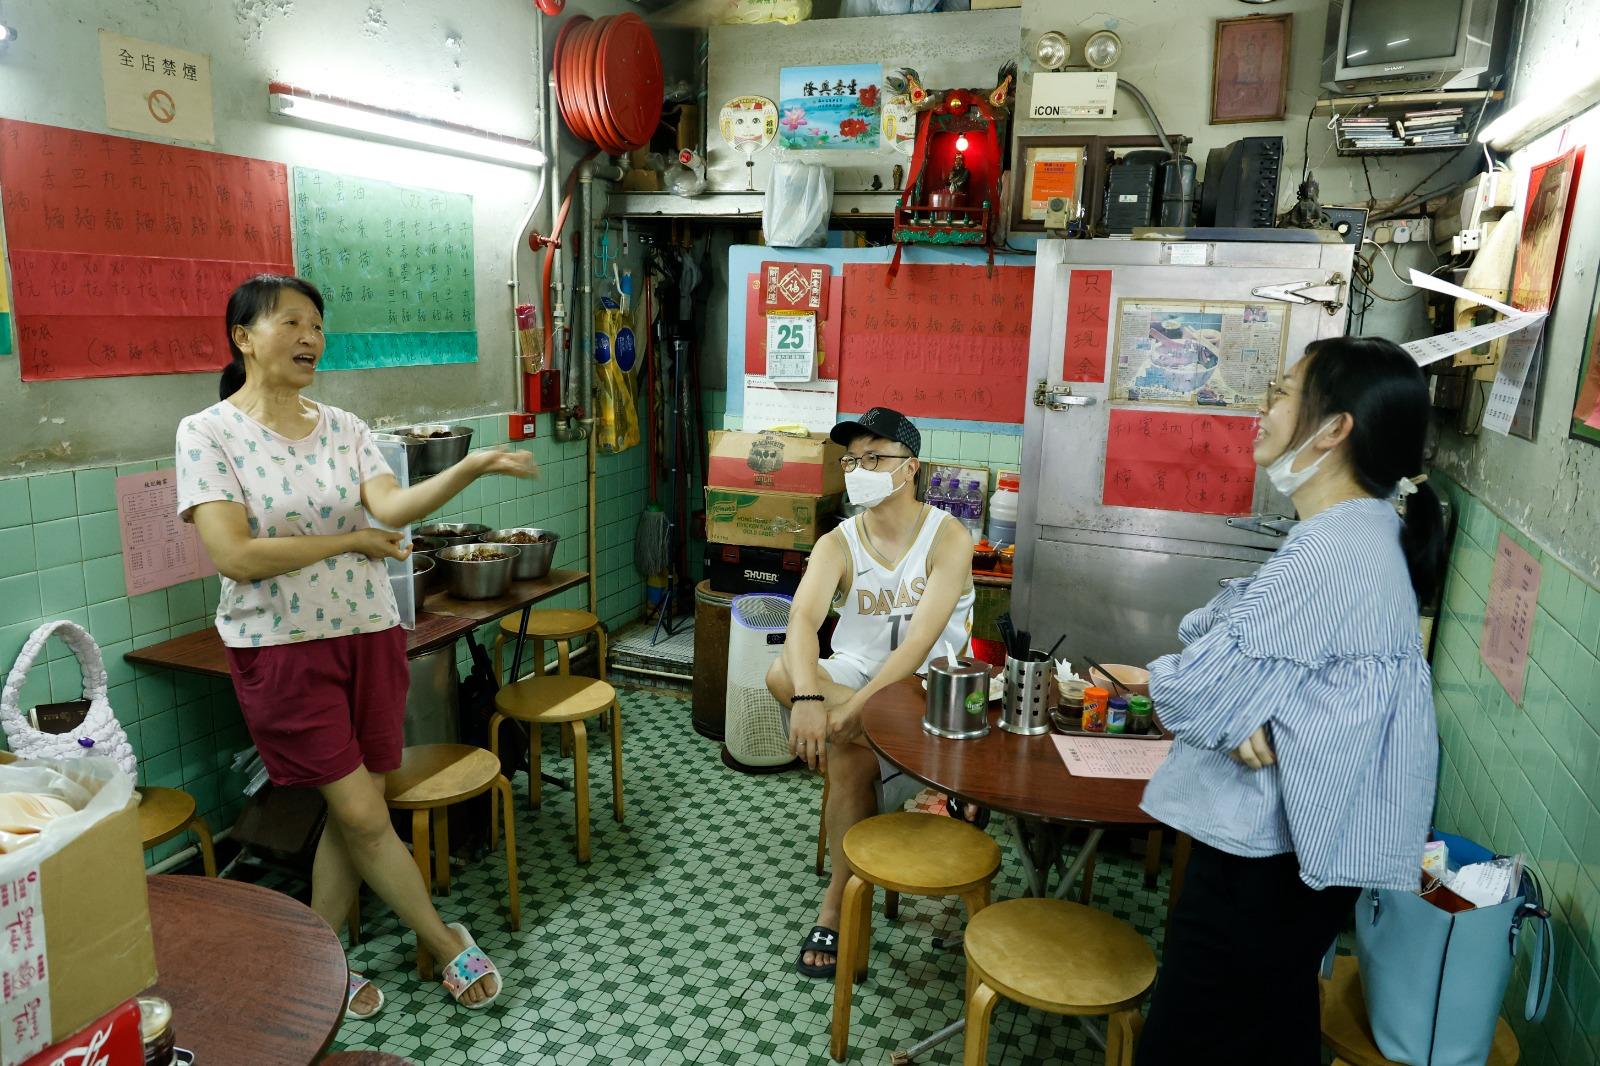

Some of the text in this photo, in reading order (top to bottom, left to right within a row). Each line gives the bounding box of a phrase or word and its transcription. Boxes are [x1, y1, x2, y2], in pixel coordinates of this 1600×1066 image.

[119, 48, 198, 82] 全店禁煙
[1034, 105, 1060, 116] iCON
[777, 324, 804, 350] 25
[1073, 274, 1106, 377] 只收現金
[743, 569, 779, 582] SHUTER
[888, 613, 913, 651] 7
